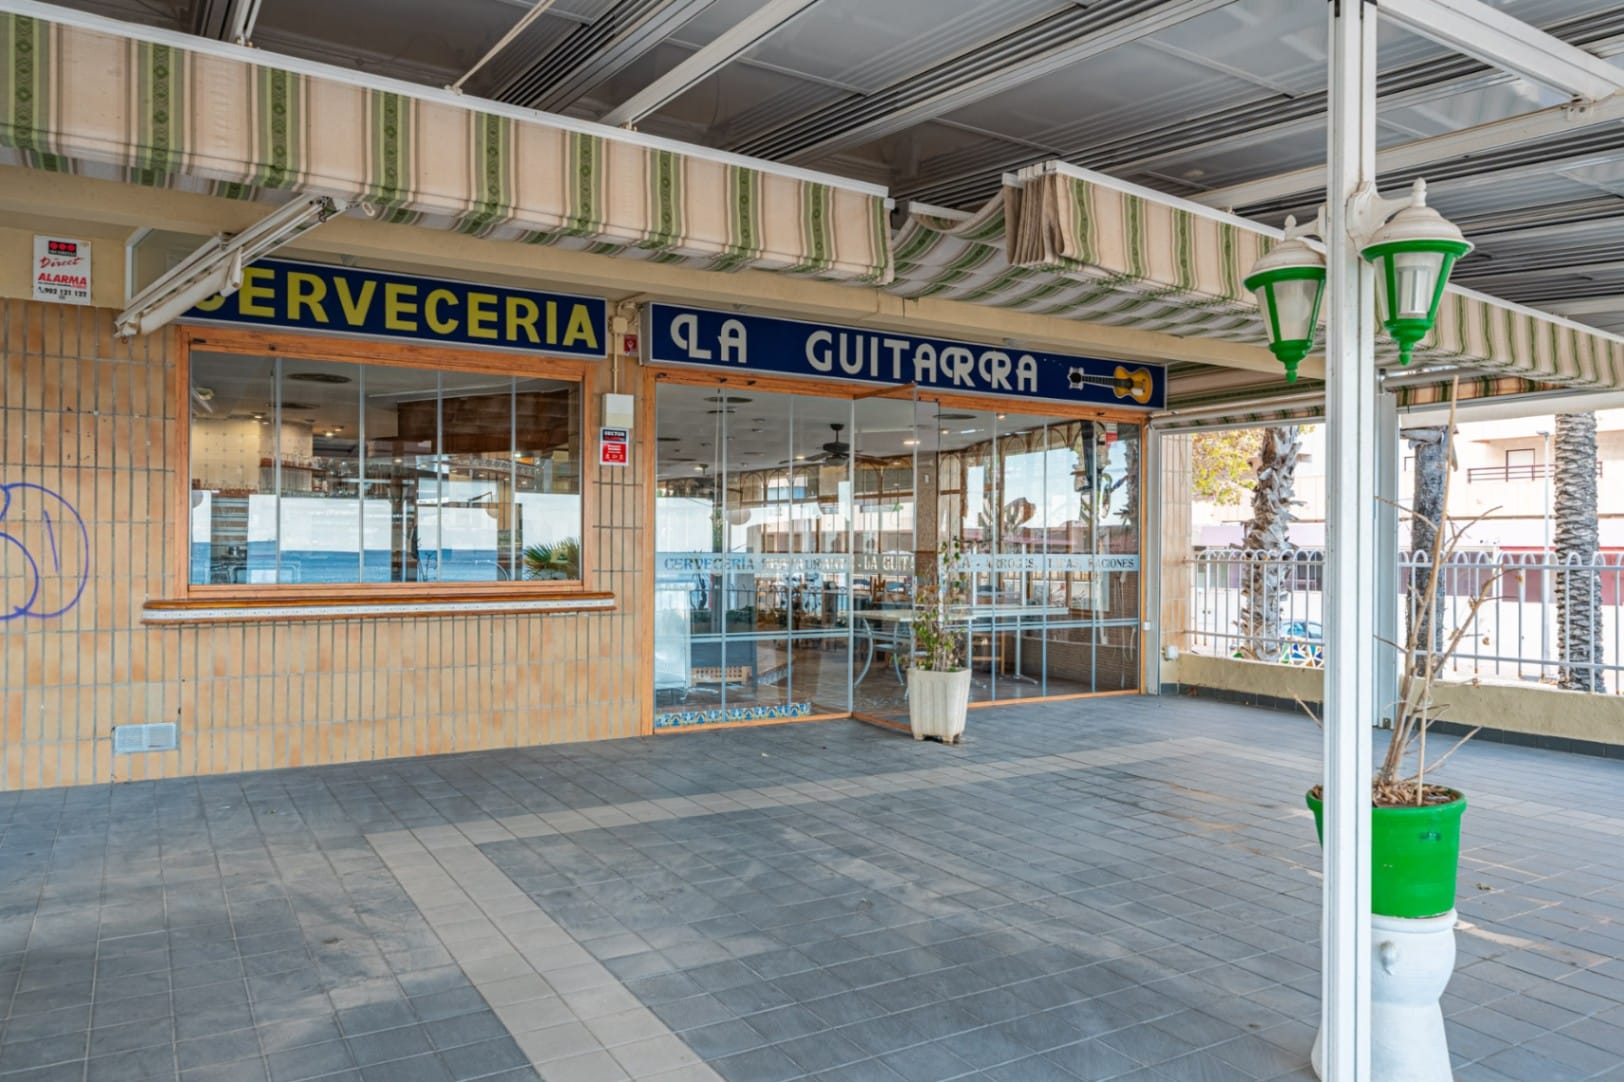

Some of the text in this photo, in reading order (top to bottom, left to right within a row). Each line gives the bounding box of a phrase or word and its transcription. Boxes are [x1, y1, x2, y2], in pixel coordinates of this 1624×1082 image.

[38, 272, 87, 286] ALARMA
[669, 313, 1039, 393] LA GUITARRA
